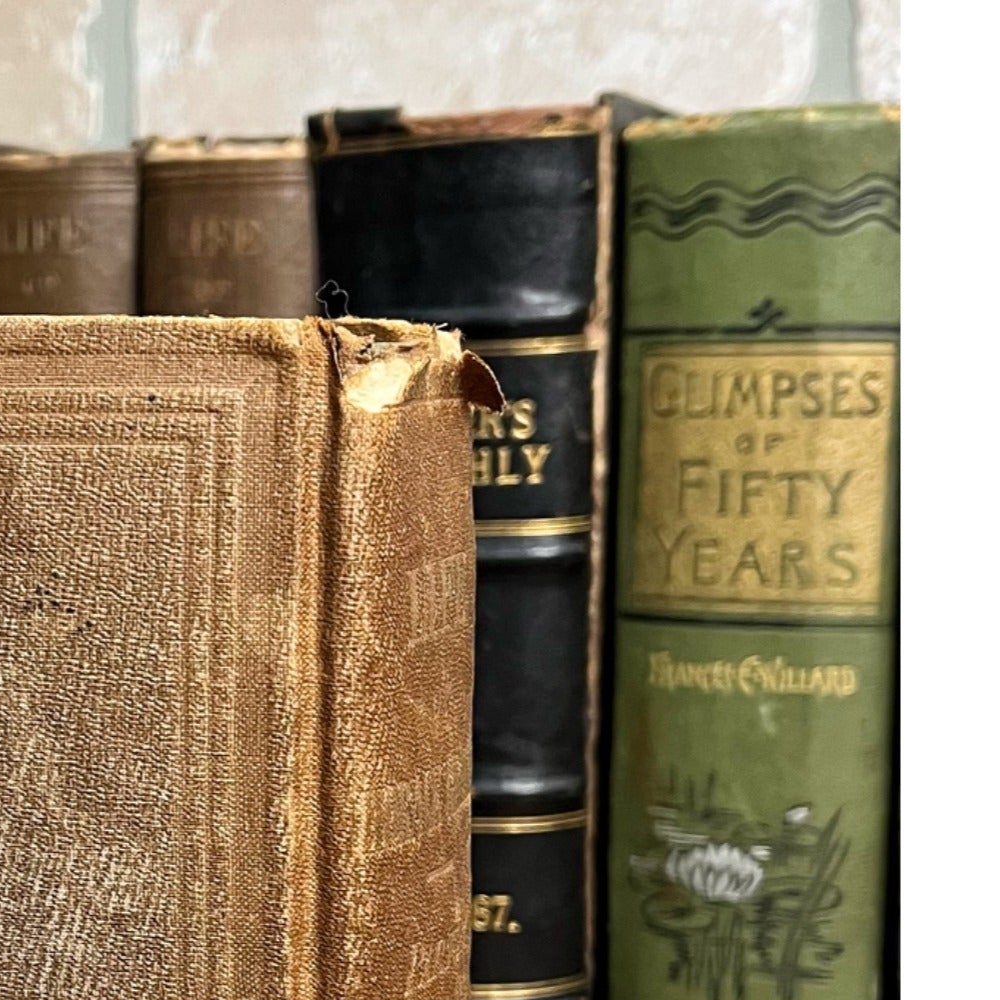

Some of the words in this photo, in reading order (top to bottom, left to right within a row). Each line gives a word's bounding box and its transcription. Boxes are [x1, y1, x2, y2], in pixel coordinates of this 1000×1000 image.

[649, 362, 882, 420] GLIMPSES
[734, 433, 786, 454] OF
[678, 459, 857, 518] FIFTY
[652, 524, 861, 587] YEARS
